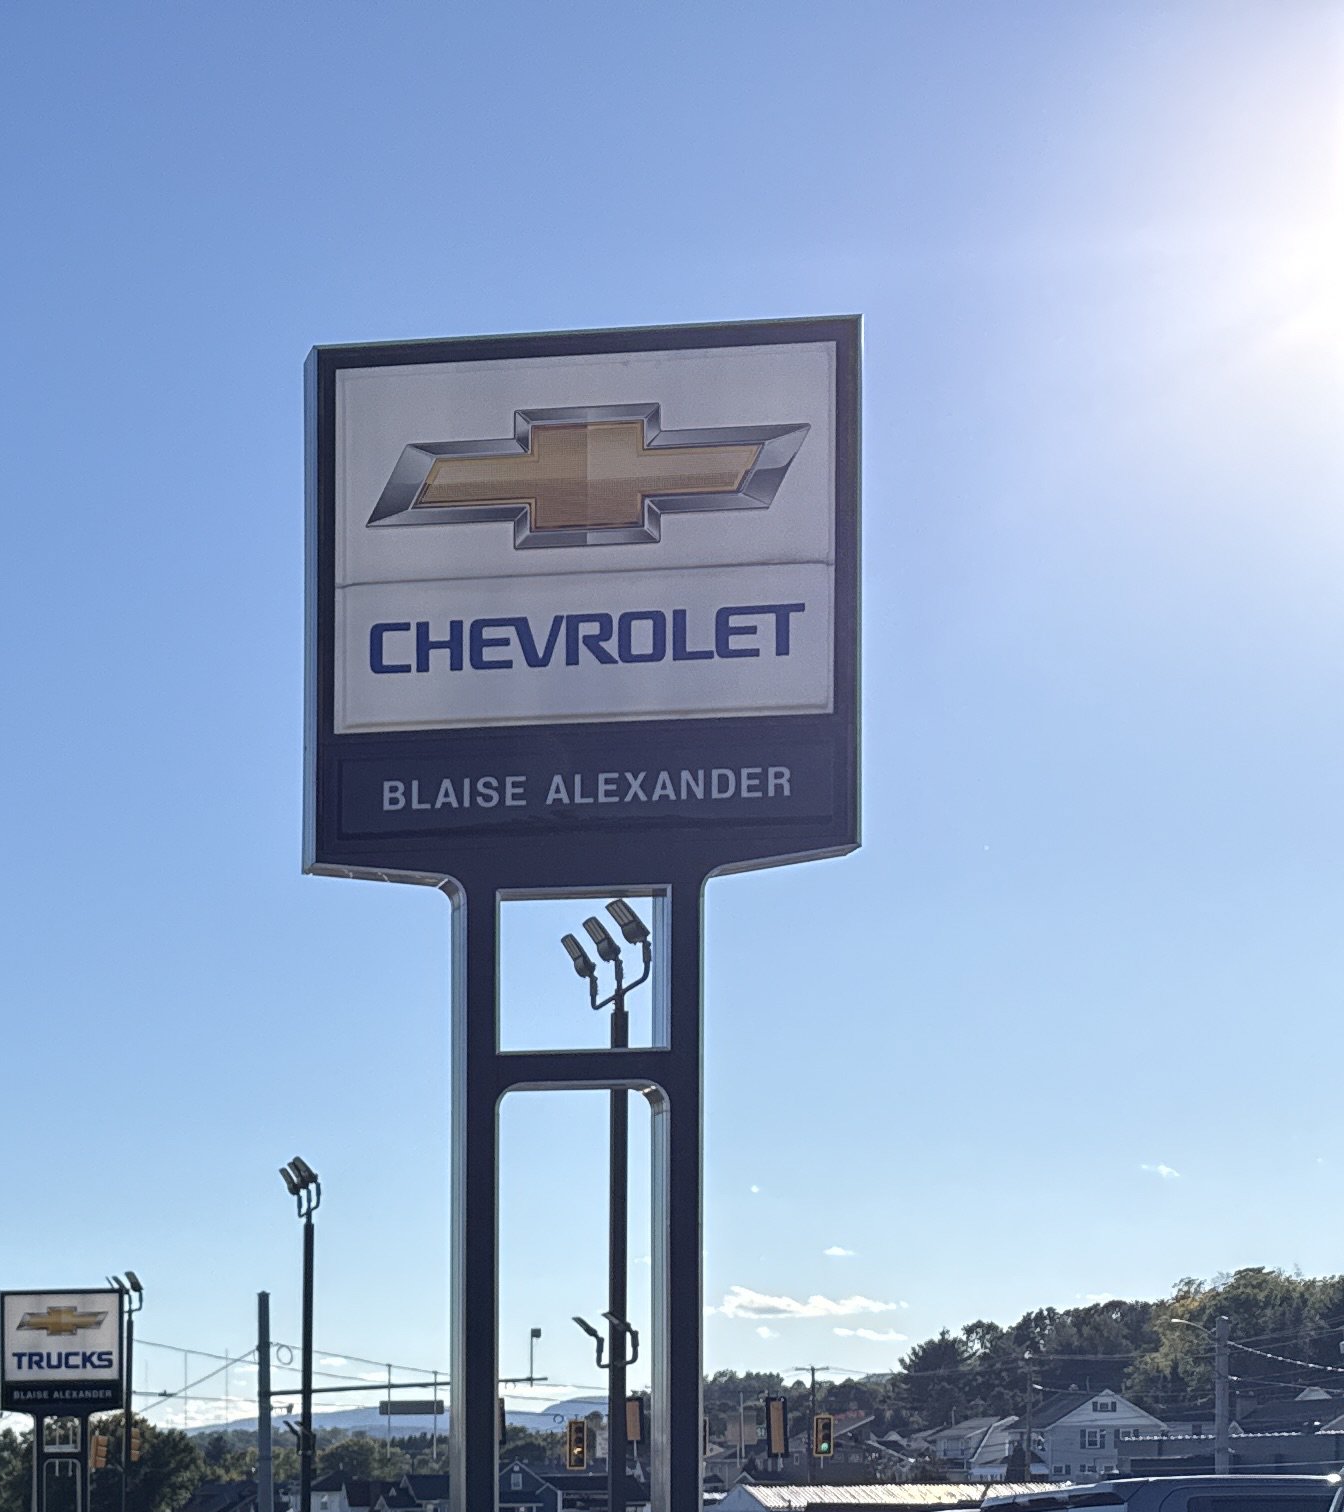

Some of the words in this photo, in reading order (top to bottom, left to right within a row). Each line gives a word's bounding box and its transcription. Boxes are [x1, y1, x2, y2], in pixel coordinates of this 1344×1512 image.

[369, 602, 806, 674] CHEVROLET
[382, 775, 528, 812] BLAISE
[545, 766, 792, 805] ALEXANDER
[12, 1351, 113, 1370] TRUCKS
[14, 1390, 49, 1399] BLAISE
[53, 1389, 112, 1399] ALEXANDER
